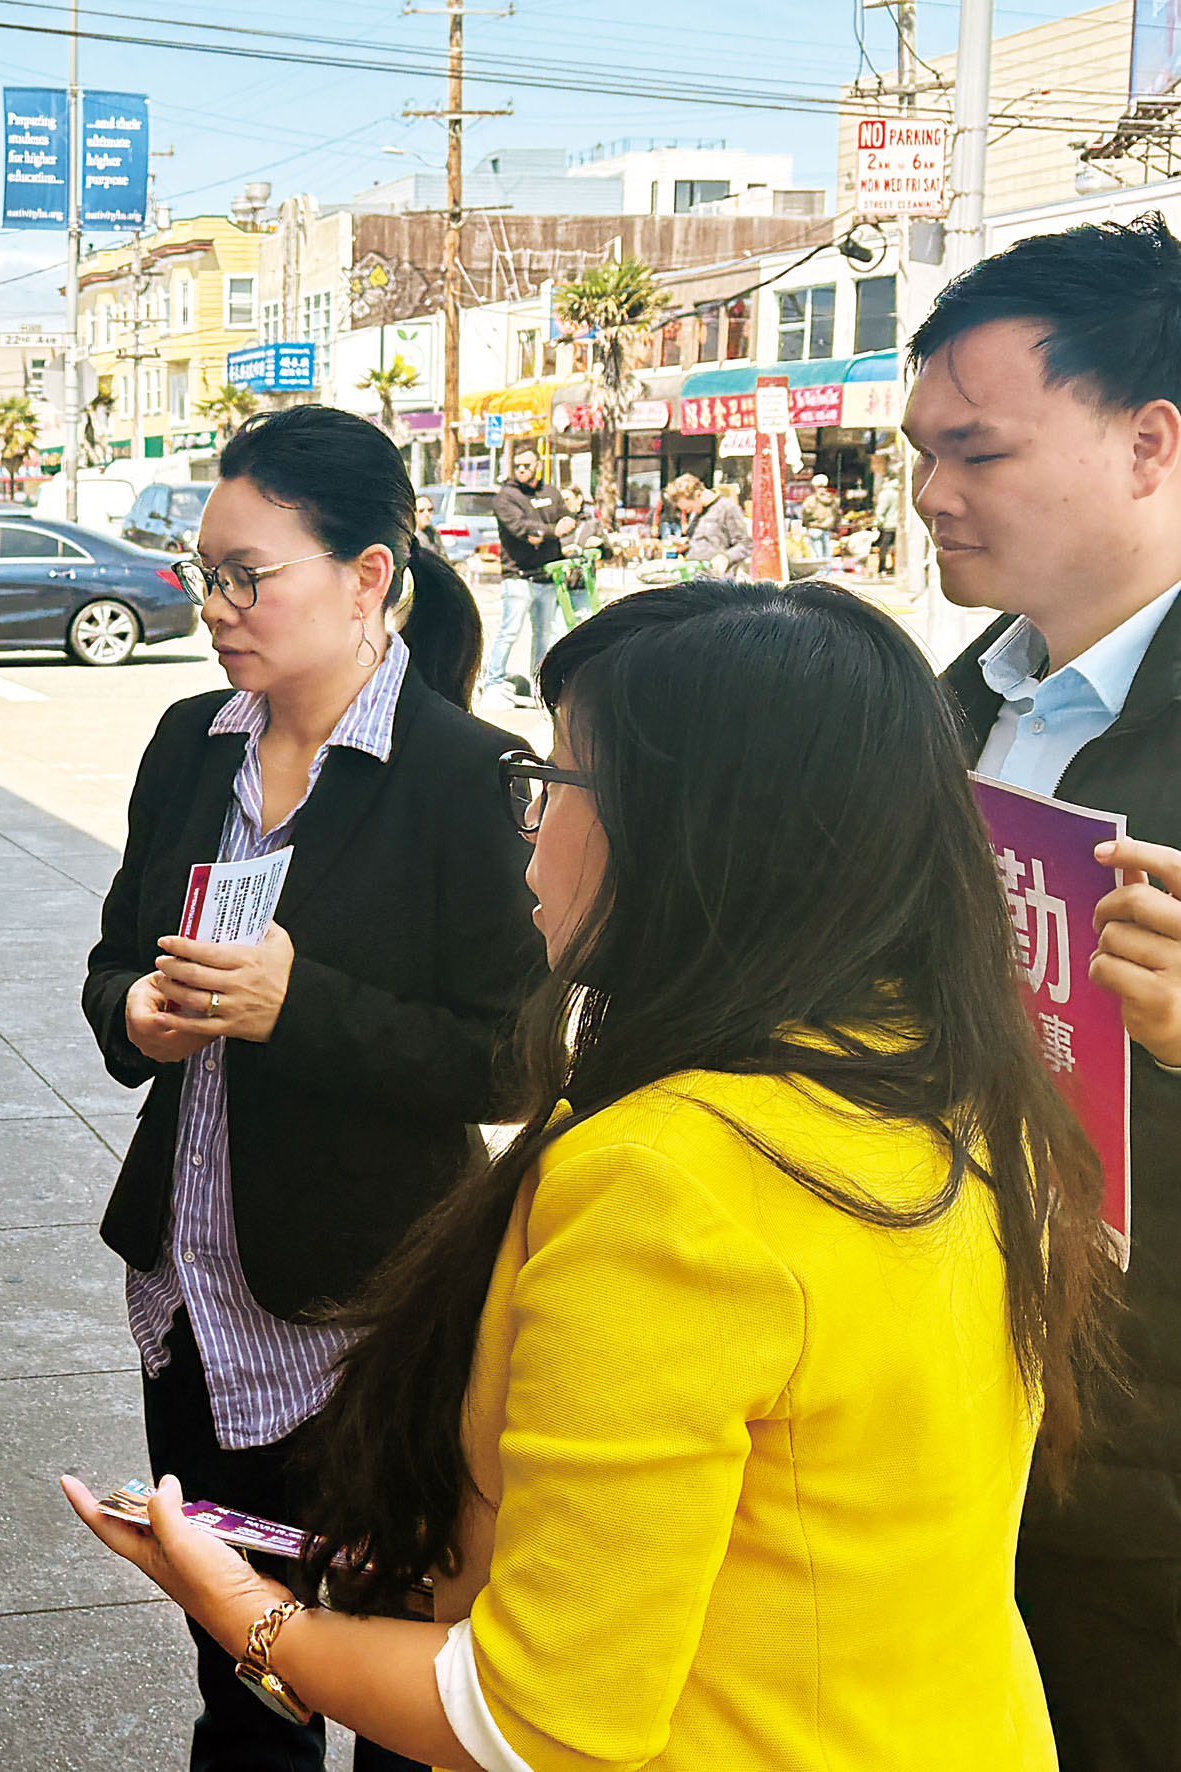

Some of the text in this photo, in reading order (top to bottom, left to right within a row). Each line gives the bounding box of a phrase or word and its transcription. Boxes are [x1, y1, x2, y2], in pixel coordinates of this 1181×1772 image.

[860, 122, 941, 147] NO PARKING
[861, 178, 940, 192] MON WED FRI SAT
